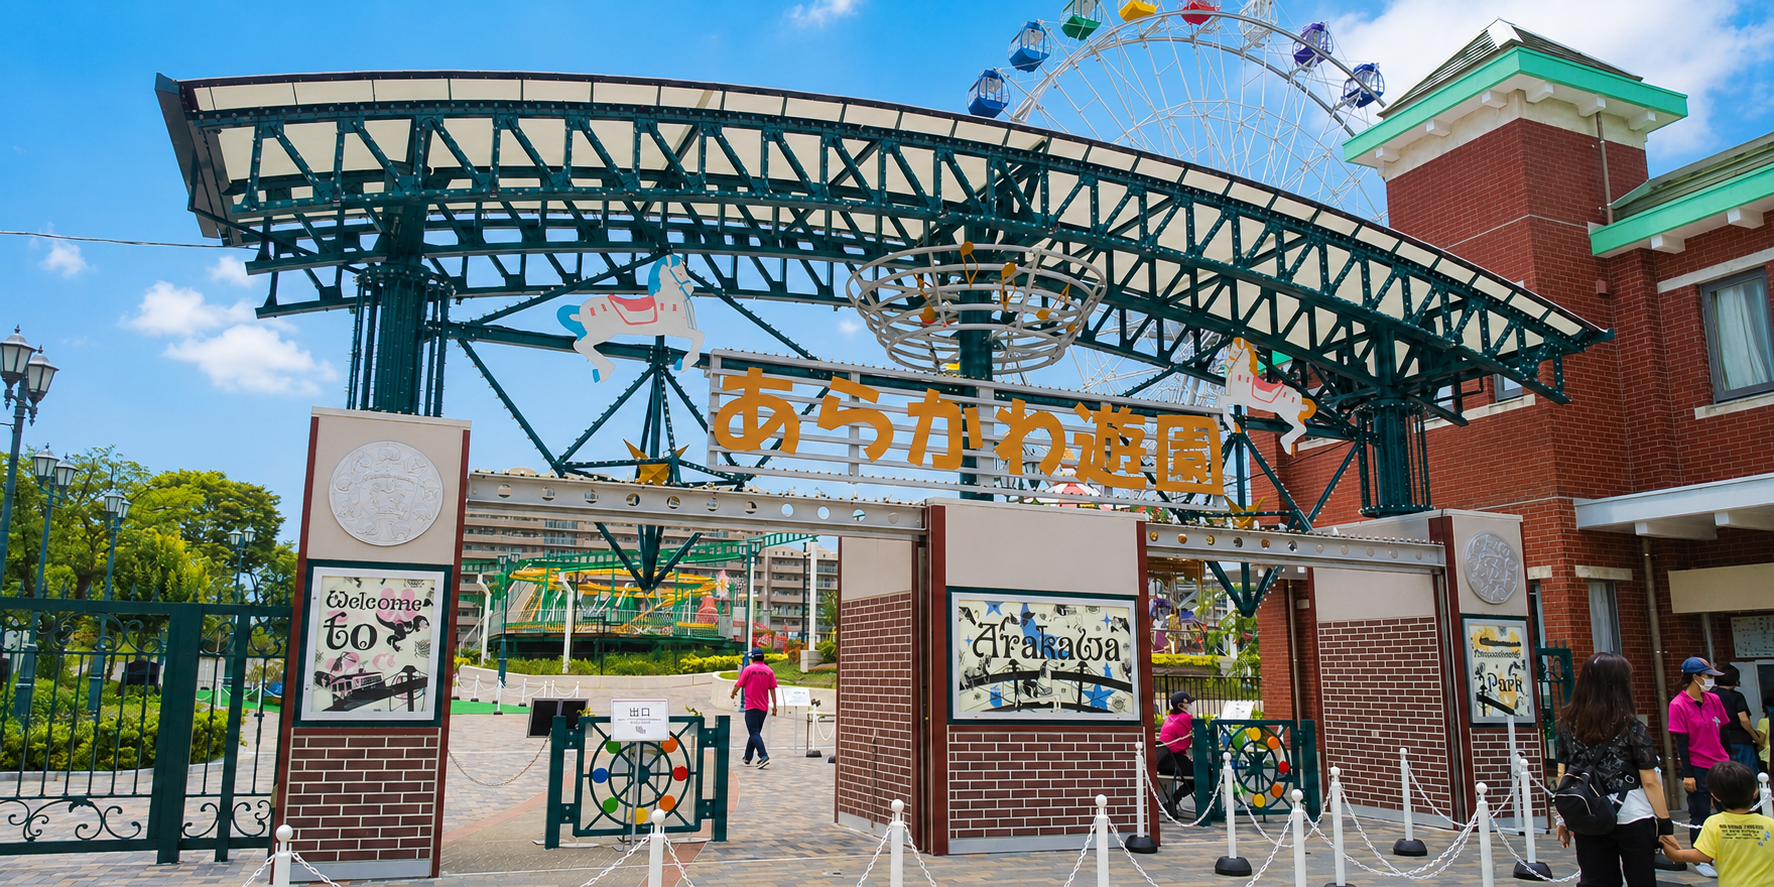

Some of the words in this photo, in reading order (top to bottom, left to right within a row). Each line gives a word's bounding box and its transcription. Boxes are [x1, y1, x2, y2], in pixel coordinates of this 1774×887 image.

[713, 366, 1226, 496] あらかわ遊園
[326, 590, 422, 611] Welcome
[323, 612, 377, 650] to
[973, 622, 1120, 661] Arakawa
[1488, 672, 1524, 694] Park
[629, 707, 650, 717] 出口
